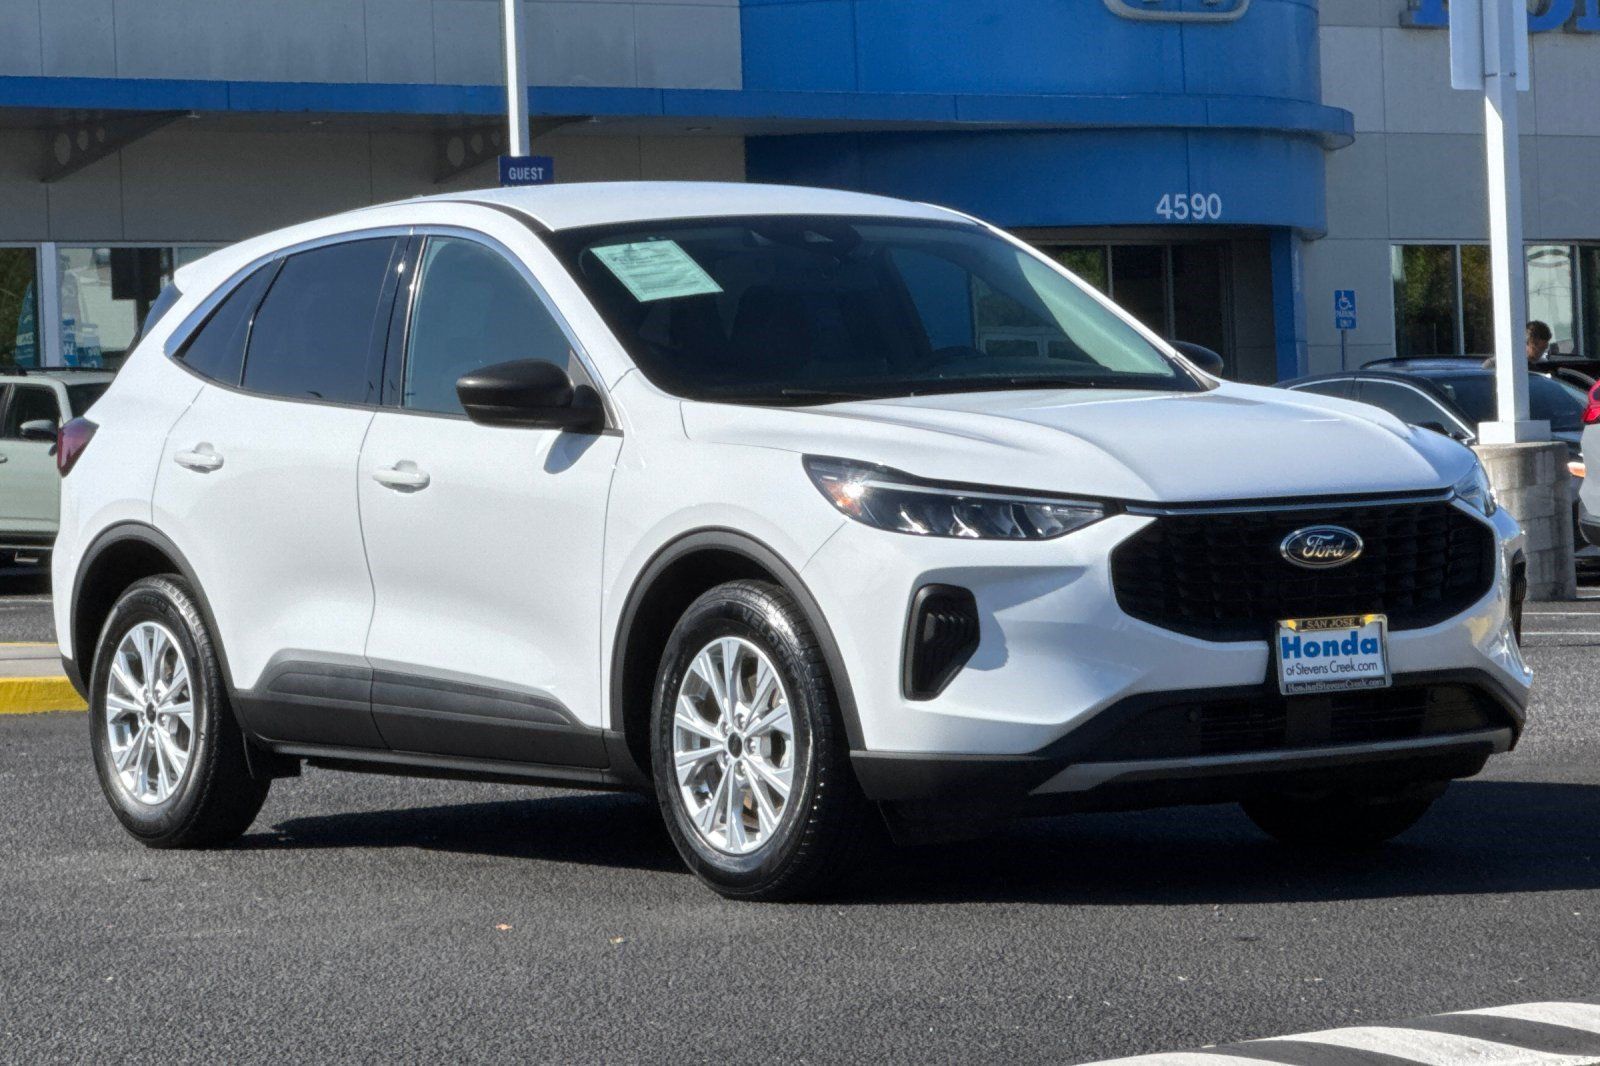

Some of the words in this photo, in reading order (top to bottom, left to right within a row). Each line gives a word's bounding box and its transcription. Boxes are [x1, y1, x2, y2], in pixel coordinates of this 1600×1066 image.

[508, 167, 544, 180] GUEST
[1156, 193, 1222, 219] 4590
[1302, 534, 1346, 557] Ford
[1307, 620, 1327, 629] SAN
[1329, 618, 1355, 628] JOSE
[1281, 630, 1378, 659] Honda
[1286, 665, 1295, 676] of
